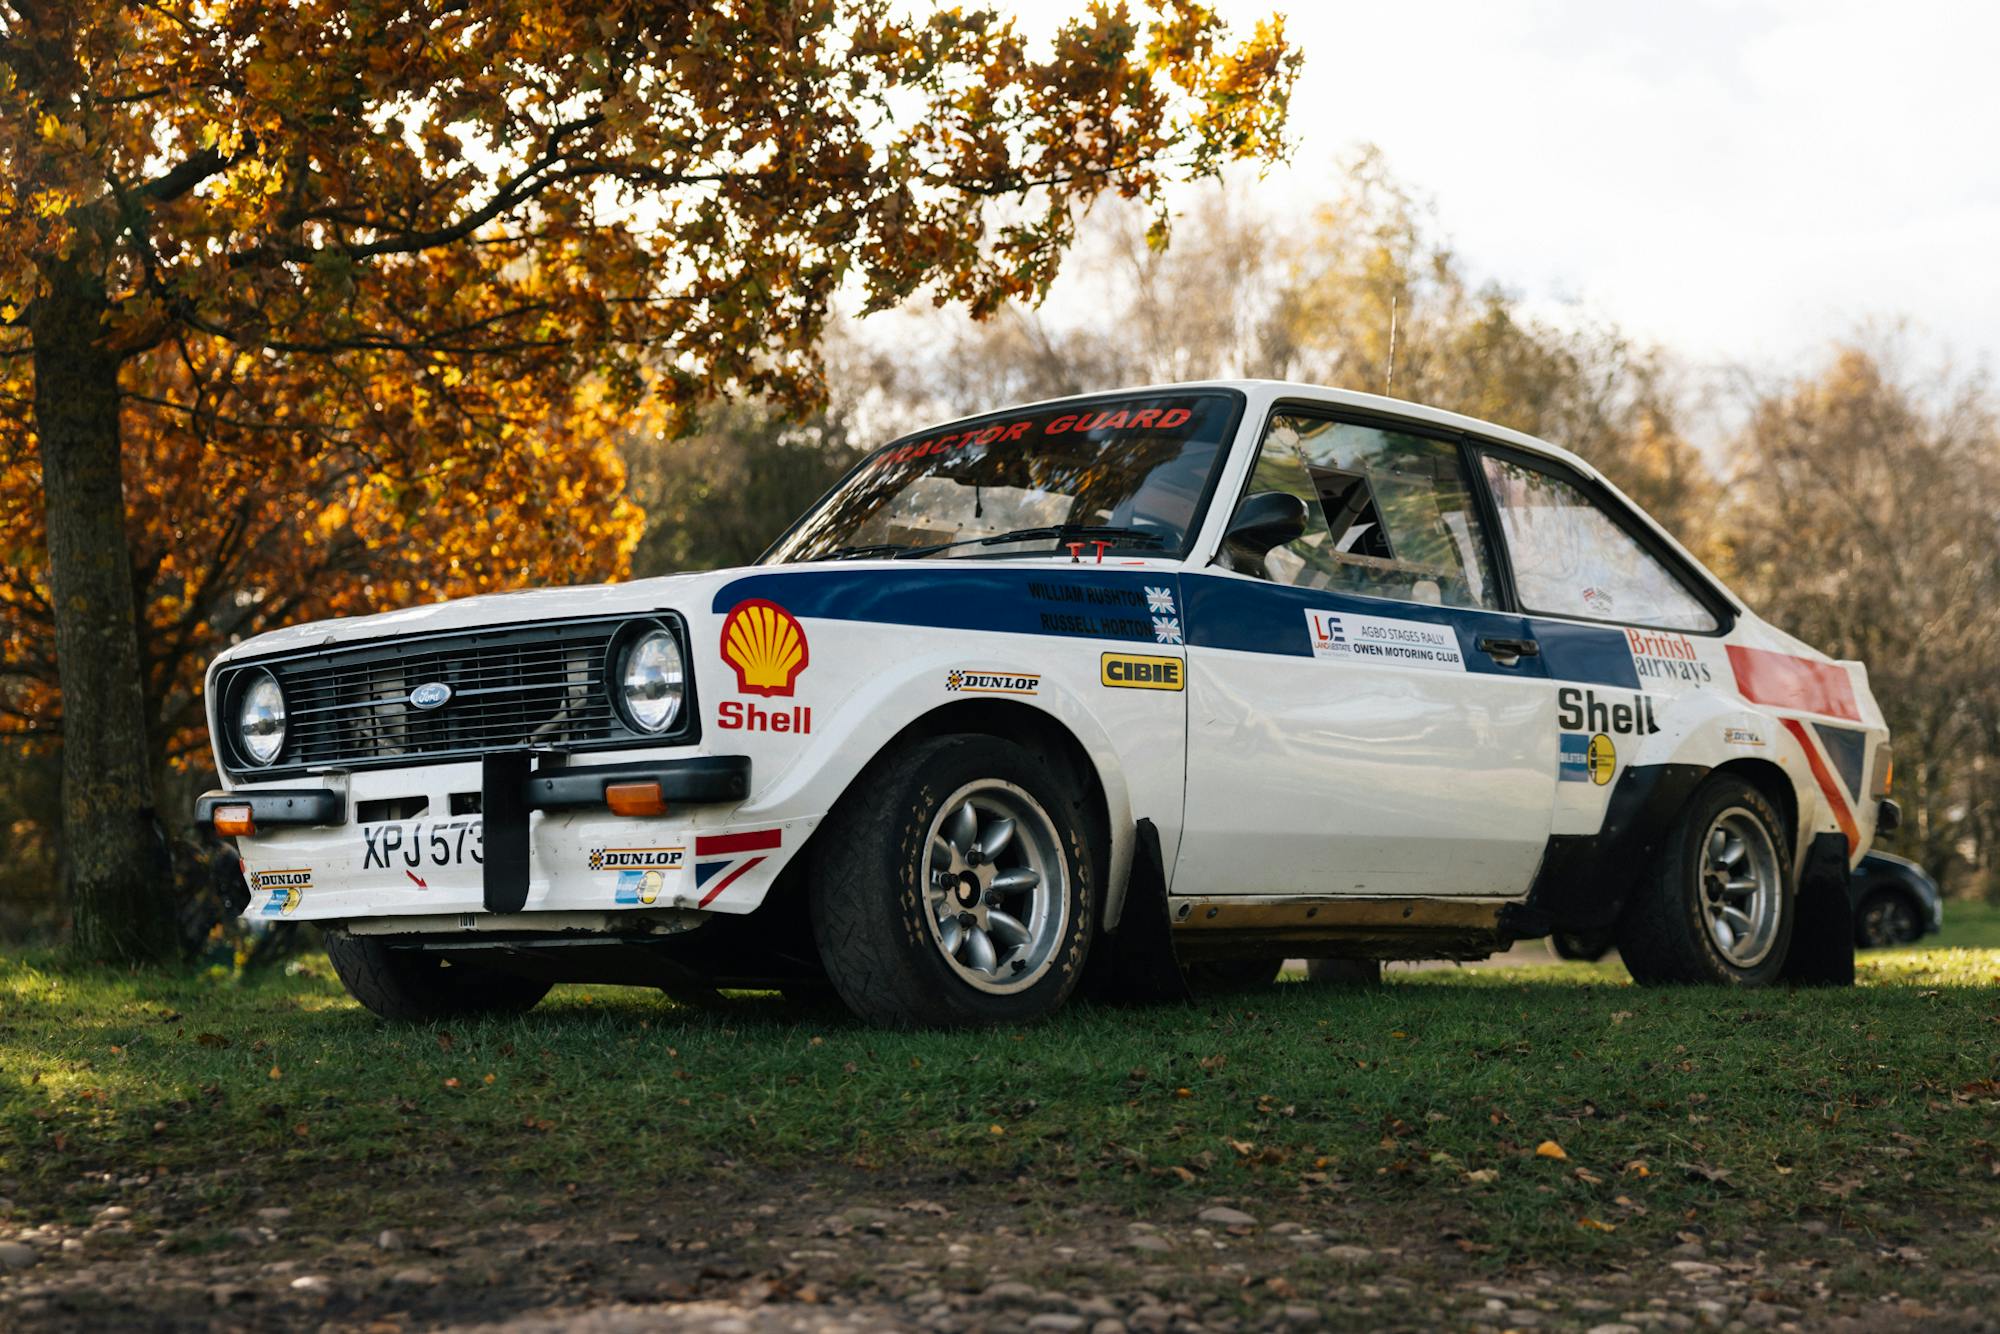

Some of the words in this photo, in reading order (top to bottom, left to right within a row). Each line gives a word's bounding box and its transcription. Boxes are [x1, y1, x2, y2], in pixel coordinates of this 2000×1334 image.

[1044, 408, 1192, 436] GUARD
[1028, 582, 1083, 603] WILLIAM
[1087, 587, 1146, 608] RUSHTON
[1040, 612, 1097, 634] RUSSELL
[1100, 617, 1152, 638] HORTON
[1361, 625, 1387, 640] AGBO
[1389, 627, 1420, 643] STAGES
[1421, 632, 1446, 646] RALLY
[1353, 643, 1384, 656] OWEN
[1385, 647, 1434, 661] MOTORING
[1436, 652, 1460, 663] CLUB
[1624, 627, 1697, 661] British
[963, 675, 1039, 690] DUNLOP
[1635, 656, 1711, 689] airways
[717, 701, 811, 734] Shell
[1558, 687, 1661, 736] Shell
[363, 823, 422, 870] XPJ
[430, 821, 484, 866] 573
[604, 852, 683, 865] DUNLOP
[261, 873, 311, 886] DUNLOP
